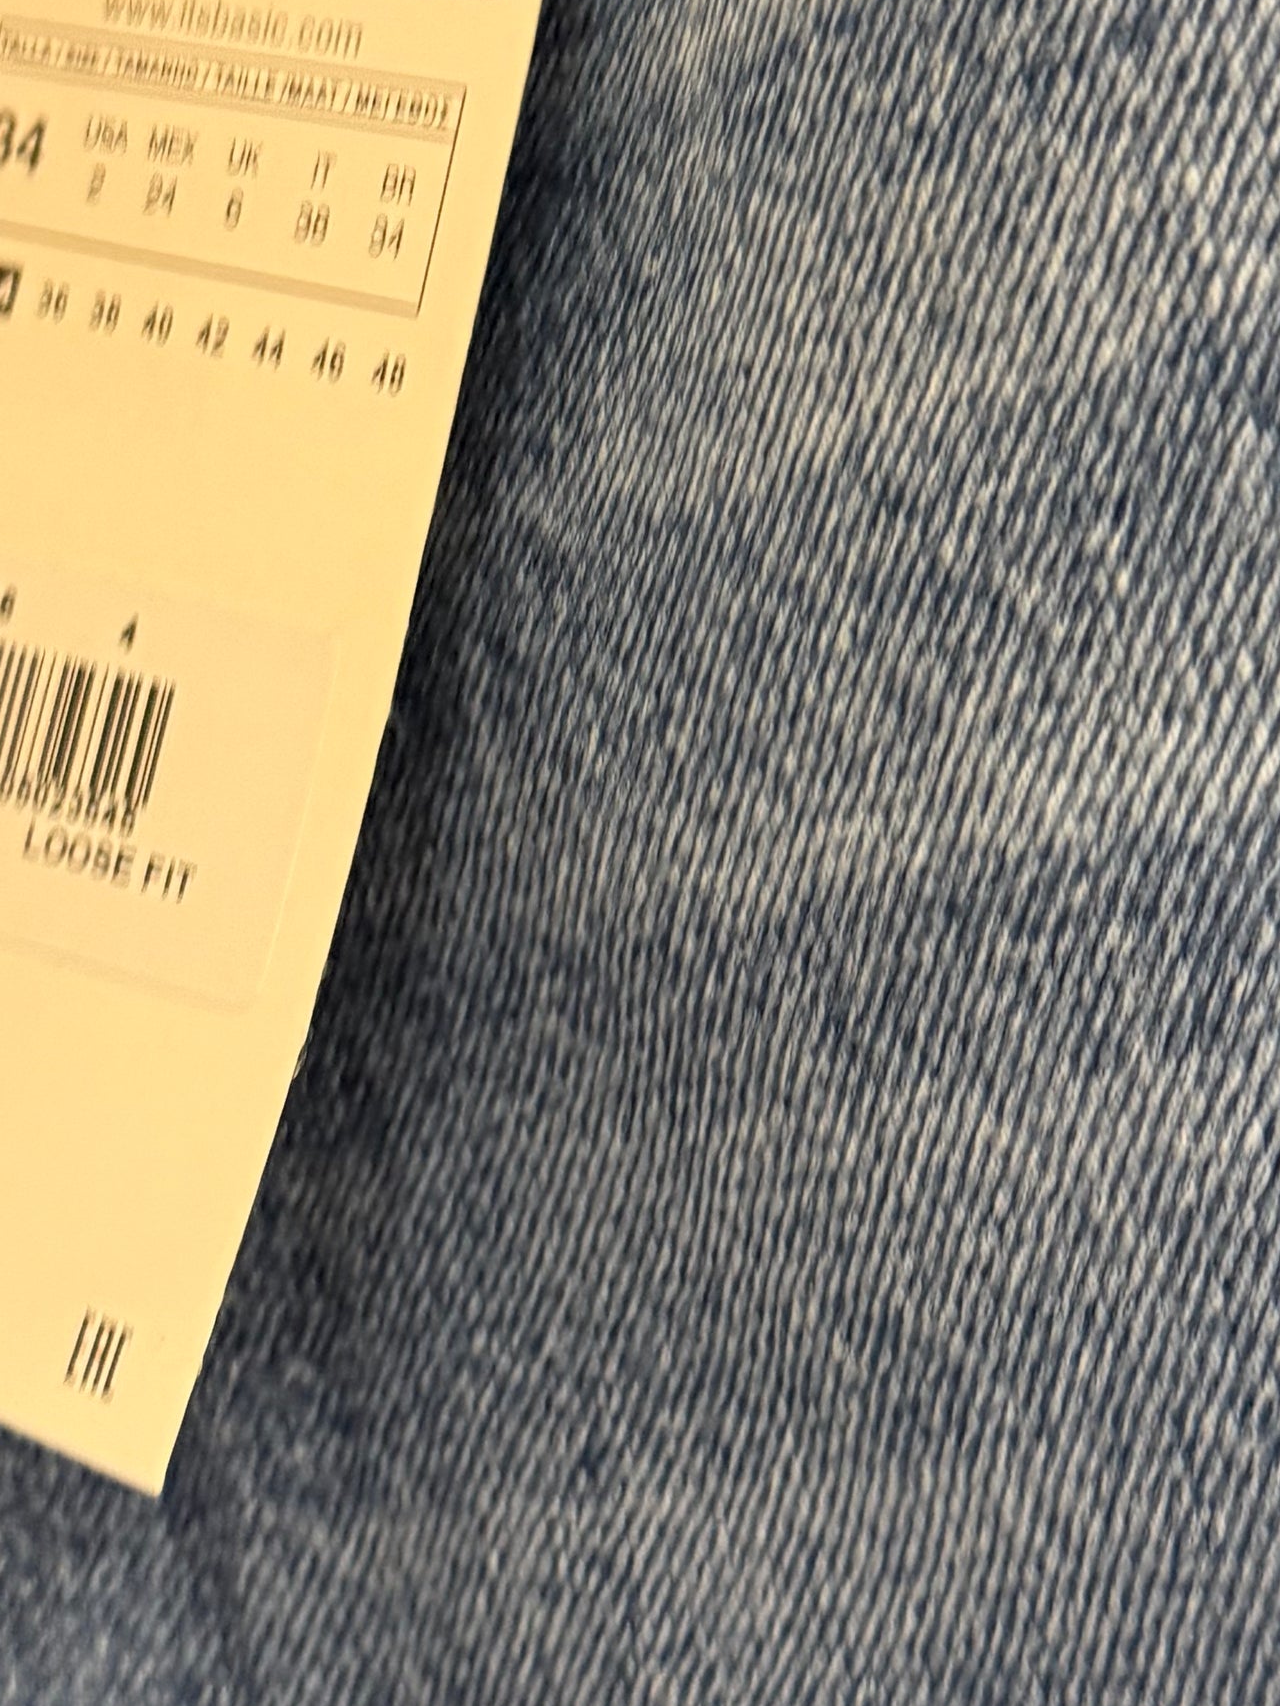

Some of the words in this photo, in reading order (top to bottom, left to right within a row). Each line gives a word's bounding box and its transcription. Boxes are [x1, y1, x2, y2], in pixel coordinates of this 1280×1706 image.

[84, 113, 129, 156] USA
[147, 123, 198, 167] MEX
[227, 137, 264, 178] UK
[311, 150, 338, 191] IT
[141, 299, 175, 348] 40
[195, 312, 230, 358] 42
[252, 323, 287, 370] 44
[119, 612, 140, 654] 4
[22, 816, 138, 889] LOOSE
[139, 850, 199, 904] FIT
